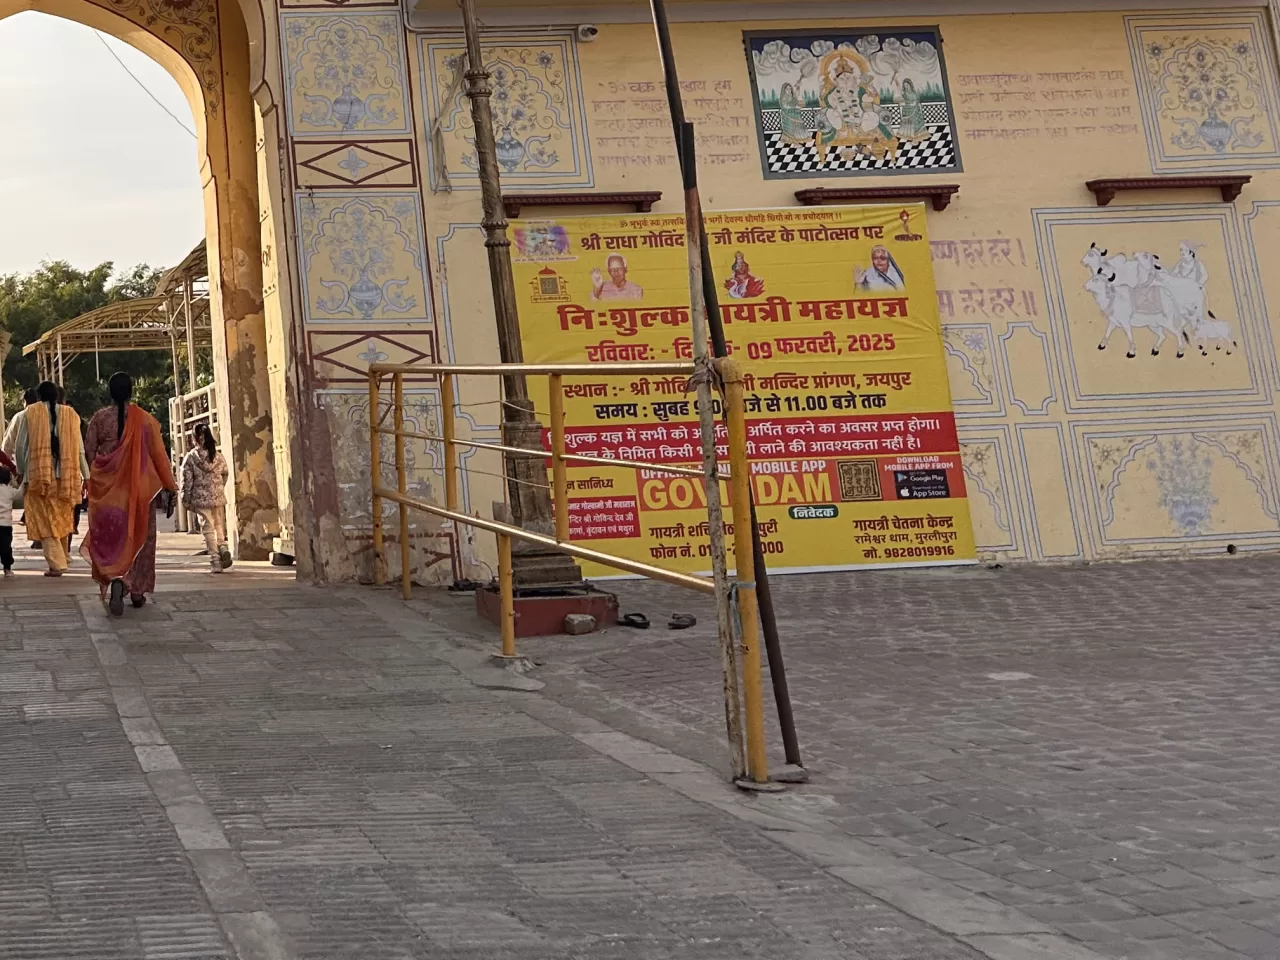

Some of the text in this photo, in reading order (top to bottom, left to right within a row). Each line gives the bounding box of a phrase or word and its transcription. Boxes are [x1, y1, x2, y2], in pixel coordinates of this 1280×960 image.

[581, 224, 885, 250] श्री राधा गोविंद जी मंदिर के पाटोत्सव पर
[705, 296, 792, 324] ायत्री
[797, 297, 909, 321] महायज्ञ
[747, 341, 773, 360] 09
[774, 331, 842, 356] फरवरी,
[847, 333, 897, 352] 2025
[562, 383, 609, 398] स्थान
[630, 377, 651, 395] श्री
[758, 372, 809, 390] मन्दिर
[811, 372, 861, 389] प्रांगण,
[863, 372, 911, 390] जयपुर
[593, 403, 638, 419] समय
[651, 400, 690, 421] सुबह
[765, 393, 781, 412] से
[784, 393, 827, 412] 11.00
[829, 391, 857, 410] बजे
[859, 393, 887, 409] तक
[600, 431, 622, 444] यज्ञ
[625, 427, 637, 442] में
[639, 426, 667, 442] सभी
[670, 425, 688, 440] को
[748, 422, 782, 437] अर्पित
[785, 420, 815, 436] करने
[819, 422, 836, 435] का
[840, 420, 878, 434] अवसर
[659, 443, 694, 458] किसी
[760, 439, 785, 454] लाने
[789, 438, 807, 453] की
[811, 439, 878, 452] आवश्यकता
[881, 435, 903, 450] नहीं
[751, 460, 799, 474] MOBILE
[802, 459, 827, 472] APP
[884, 463, 914, 471] MOBILE
[897, 456, 939, 464] DOWNLOAD
[576, 477, 614, 490] सानिध्य
[931, 474, 944, 482] Play
[913, 490, 928, 498] App
[568, 514, 583, 523] न्दिर
[793, 506, 835, 518] निवेदक
[852, 513, 954, 531] गायत्री चेतना केन्द्र
[649, 523, 685, 539] गायत्री
[853, 531, 958, 545] रामेश्वर धाम, मुरलीपुरा
[650, 544, 677, 559] फोन
[679, 542, 695, 558] नं.
[862, 545, 955, 560] मो. 9828019916
